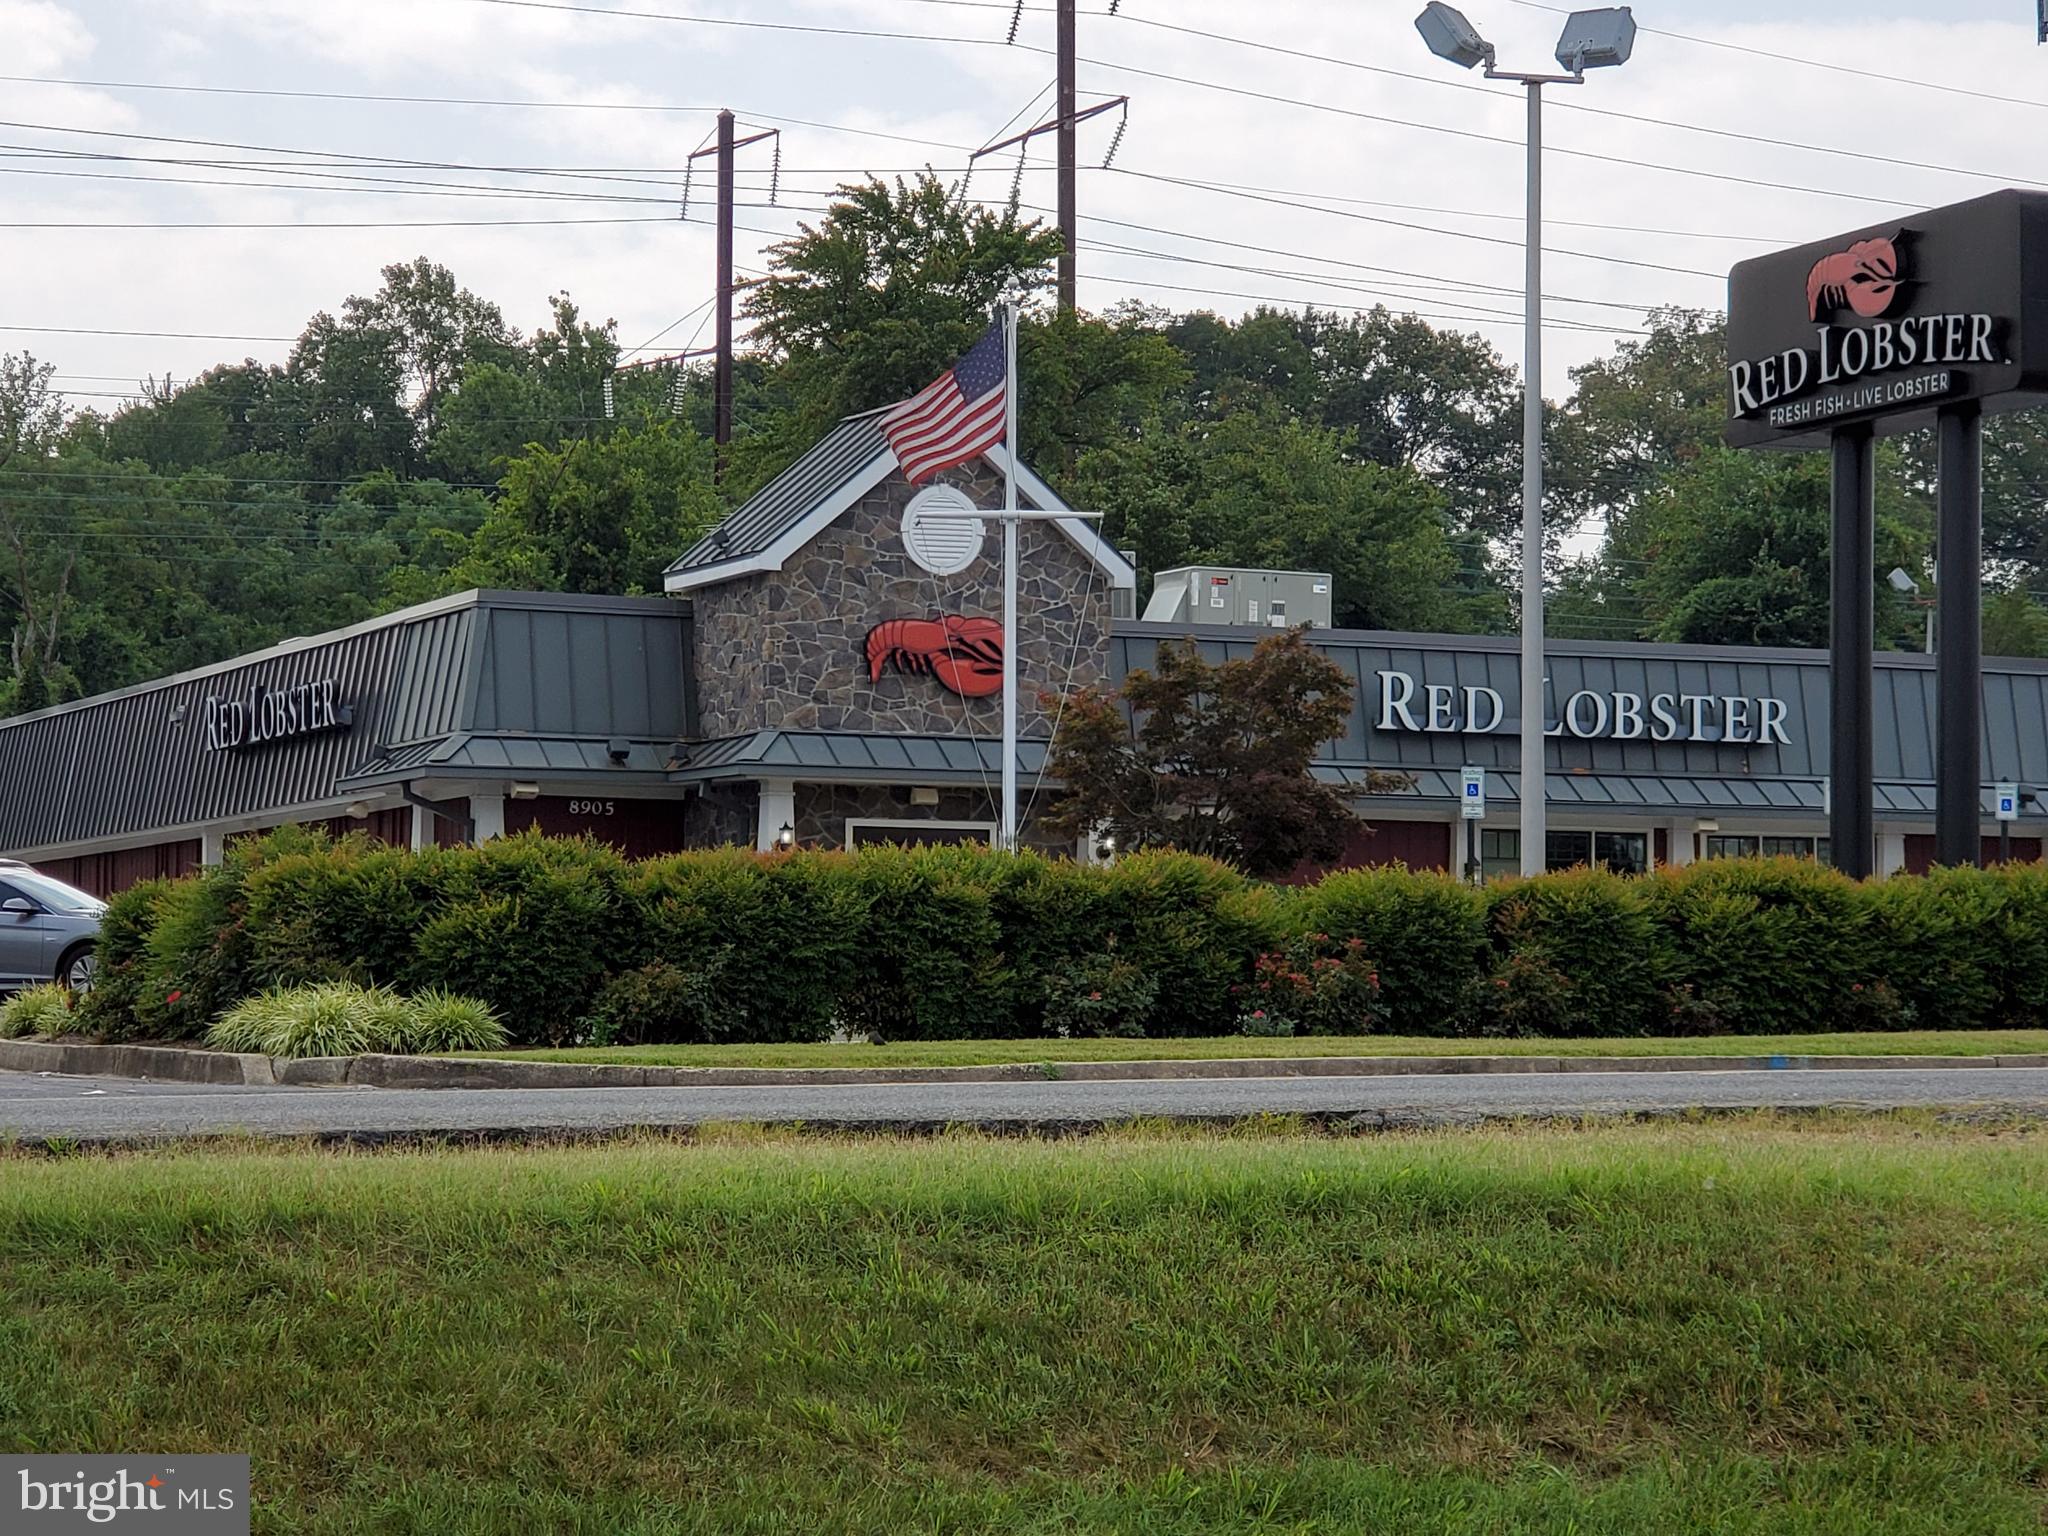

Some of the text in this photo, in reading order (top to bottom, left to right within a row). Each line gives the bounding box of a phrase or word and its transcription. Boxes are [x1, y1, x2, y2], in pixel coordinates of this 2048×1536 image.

[1729, 313, 1994, 419] RED LOBSTER
[1769, 372, 1949, 426] FRESH FISH LIVE LOBSTER
[206, 679, 336, 751] RED LOBSTER
[1376, 670, 1504, 734] RED
[569, 800, 614, 816] 8905
